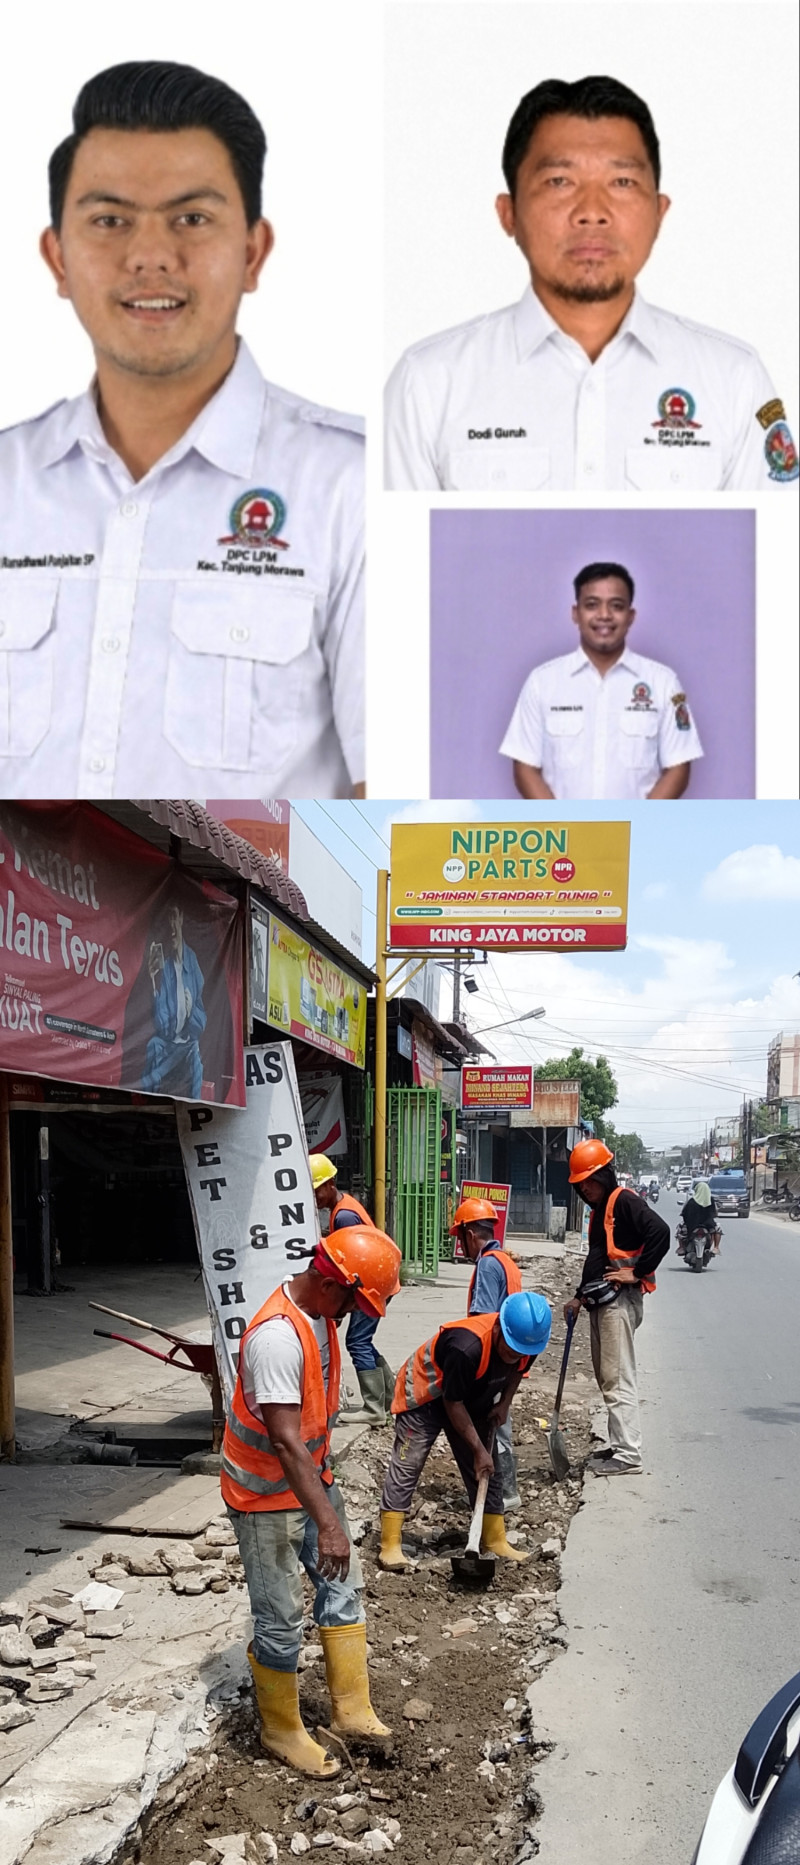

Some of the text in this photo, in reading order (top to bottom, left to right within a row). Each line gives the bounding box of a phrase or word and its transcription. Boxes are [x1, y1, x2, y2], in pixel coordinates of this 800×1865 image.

[468, 428, 492, 440] Dodi
[227, 549, 277, 563] DPC LPM
[221, 561, 262, 576] Tanjung
[264, 564, 305, 577] Morawa
[452, 829, 566, 854] NIPPON
[468, 858, 548, 880] PARTS
[554, 862, 573, 872] NPR
[416, 890, 477, 902] JAMINAN
[479, 890, 553, 901] STANDART
[557, 890, 599, 901] DUNIA
[429, 928, 587, 942] KING JAYA MOTOR
[56, 913, 124, 988] Terus
[3, 983, 23, 999] SINYAL
[482, 1073, 506, 1082] RUMAH
[507, 1073, 530, 1082] MAKAN
[187, 1108, 227, 1202] PET
[249, 1224, 269, 1250] &
